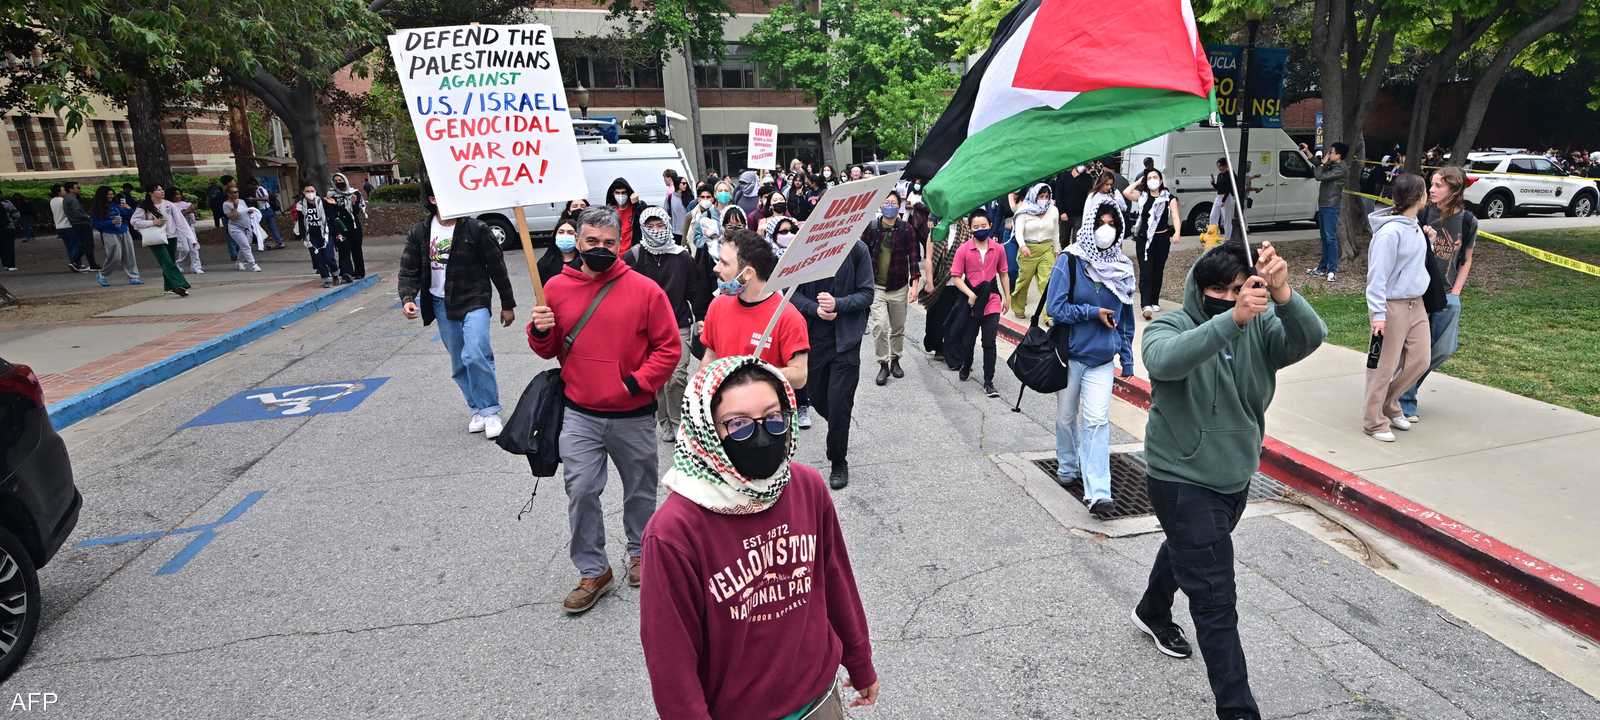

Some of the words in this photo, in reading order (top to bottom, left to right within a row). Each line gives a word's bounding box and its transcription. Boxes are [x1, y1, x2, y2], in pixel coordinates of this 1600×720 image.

[405, 27, 499, 51] DEFEND
[508, 29, 547, 46] THE
[409, 50, 551, 80] PALESTINIANS
[1209, 56, 1236, 69] UCLA
[438, 72, 522, 90] AGAINST
[425, 115, 560, 141] GENOCIDAL
[754, 128, 773, 137] UAW
[450, 141, 505, 162] WAR
[512, 140, 541, 157] ON
[459, 159, 548, 191] GAZA!
[823, 189, 879, 219] UAW
[805, 225, 854, 244] WORKERS
[809, 220, 837, 233] RANK
[846, 212, 865, 224] FILE
[777, 243, 848, 278] PALESTINE
[742, 535, 766, 550] EST.
[767, 524, 790, 539] 1872
[708, 534, 817, 603] YELLOWSTON
[729, 584, 786, 620] NATIONAL
[788, 577, 812, 597] PAR
[749, 613, 772, 623] DOOR
